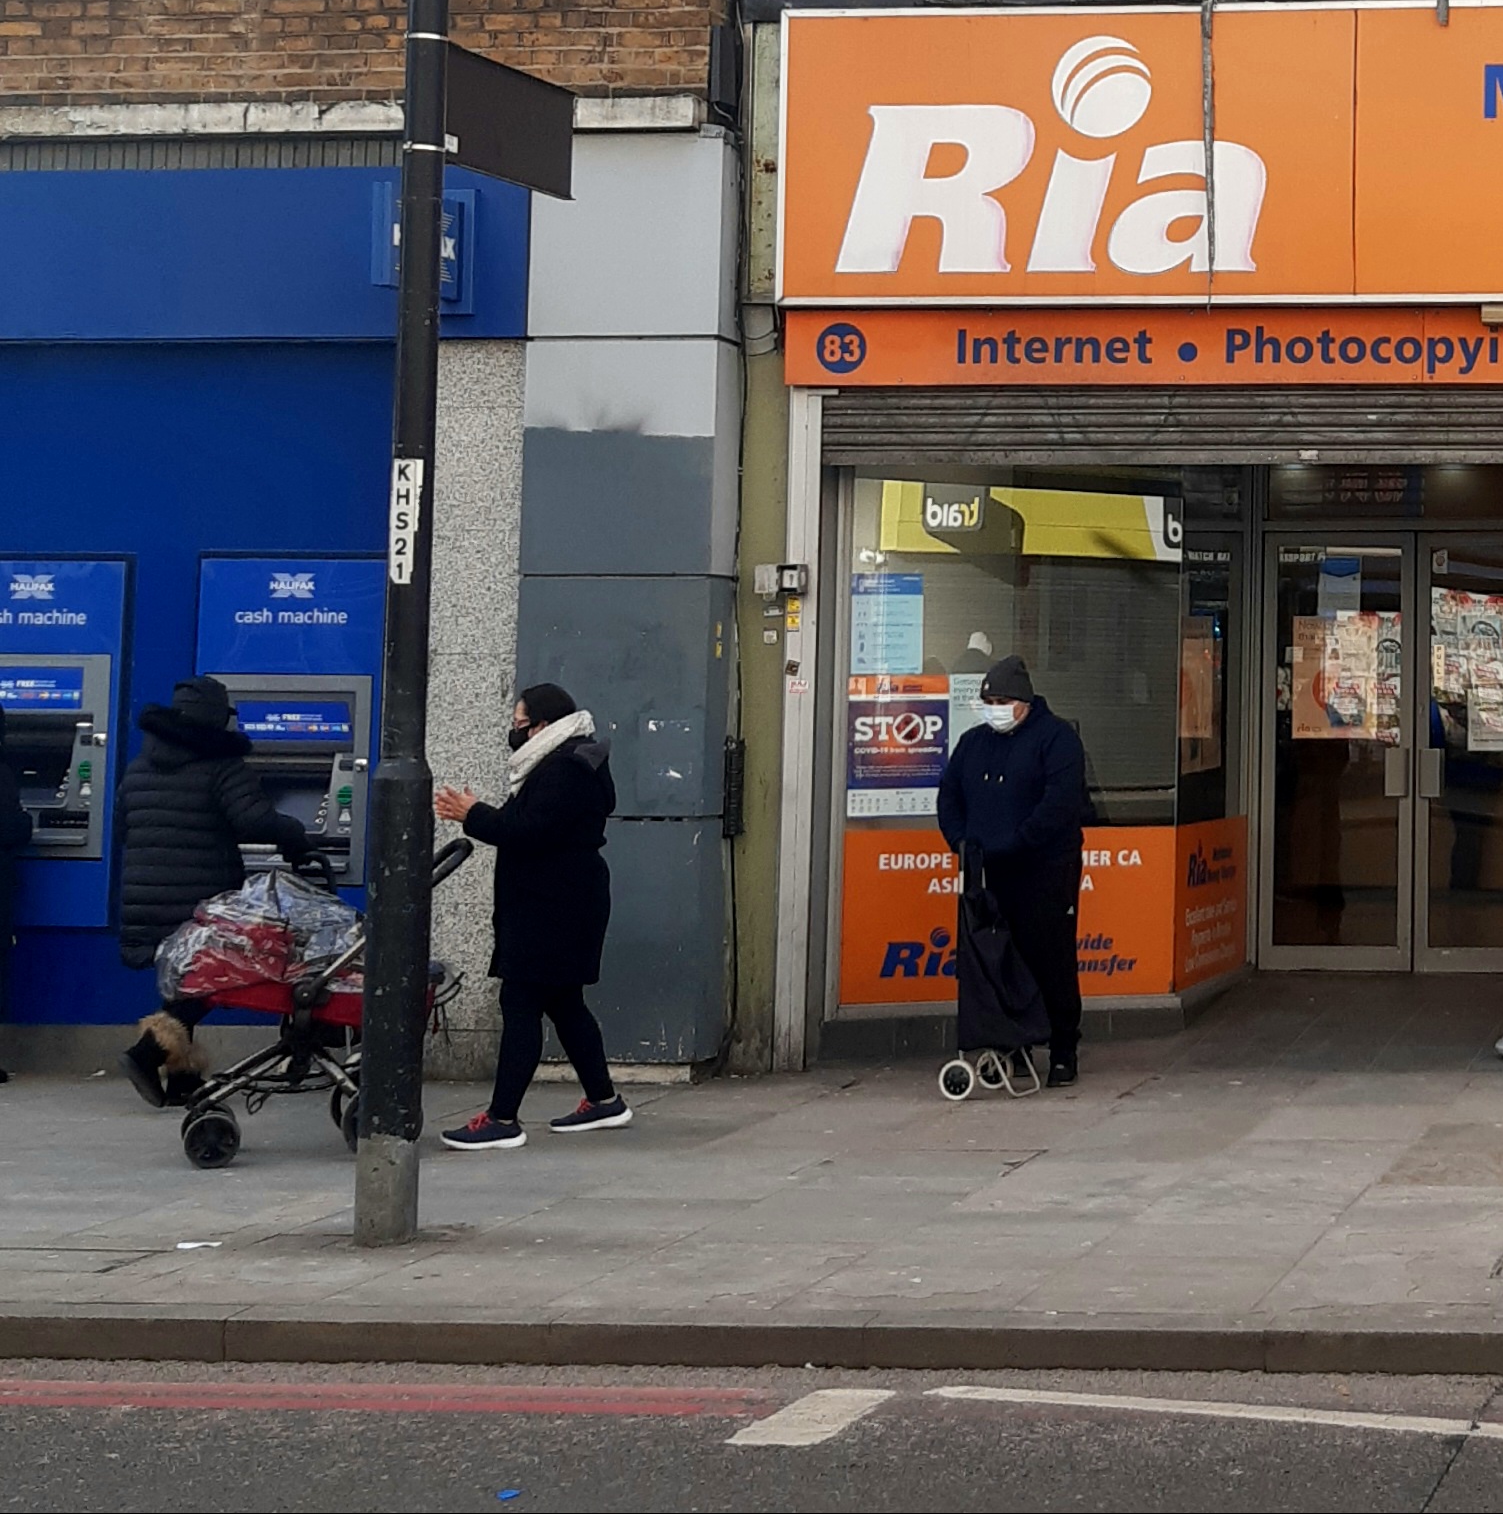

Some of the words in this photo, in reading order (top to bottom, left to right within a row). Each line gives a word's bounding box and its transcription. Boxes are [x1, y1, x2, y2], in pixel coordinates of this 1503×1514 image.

[835, 35, 1267, 274] Ria
[822, 335, 861, 363] 83
[956, 329, 1153, 365] Internet
[395, 465, 411, 579] KHS21
[10, 582, 55, 592] HALIFAX
[269, 580, 315, 591] HALIFAX
[18, 608, 86, 625] machine
[235, 608, 272, 624] cash
[278, 607, 348, 624] machine
[854, 712, 943, 745] STOP
[854, 747, 888, 755] COVID-19
[879, 854, 952, 870] EUROPE
